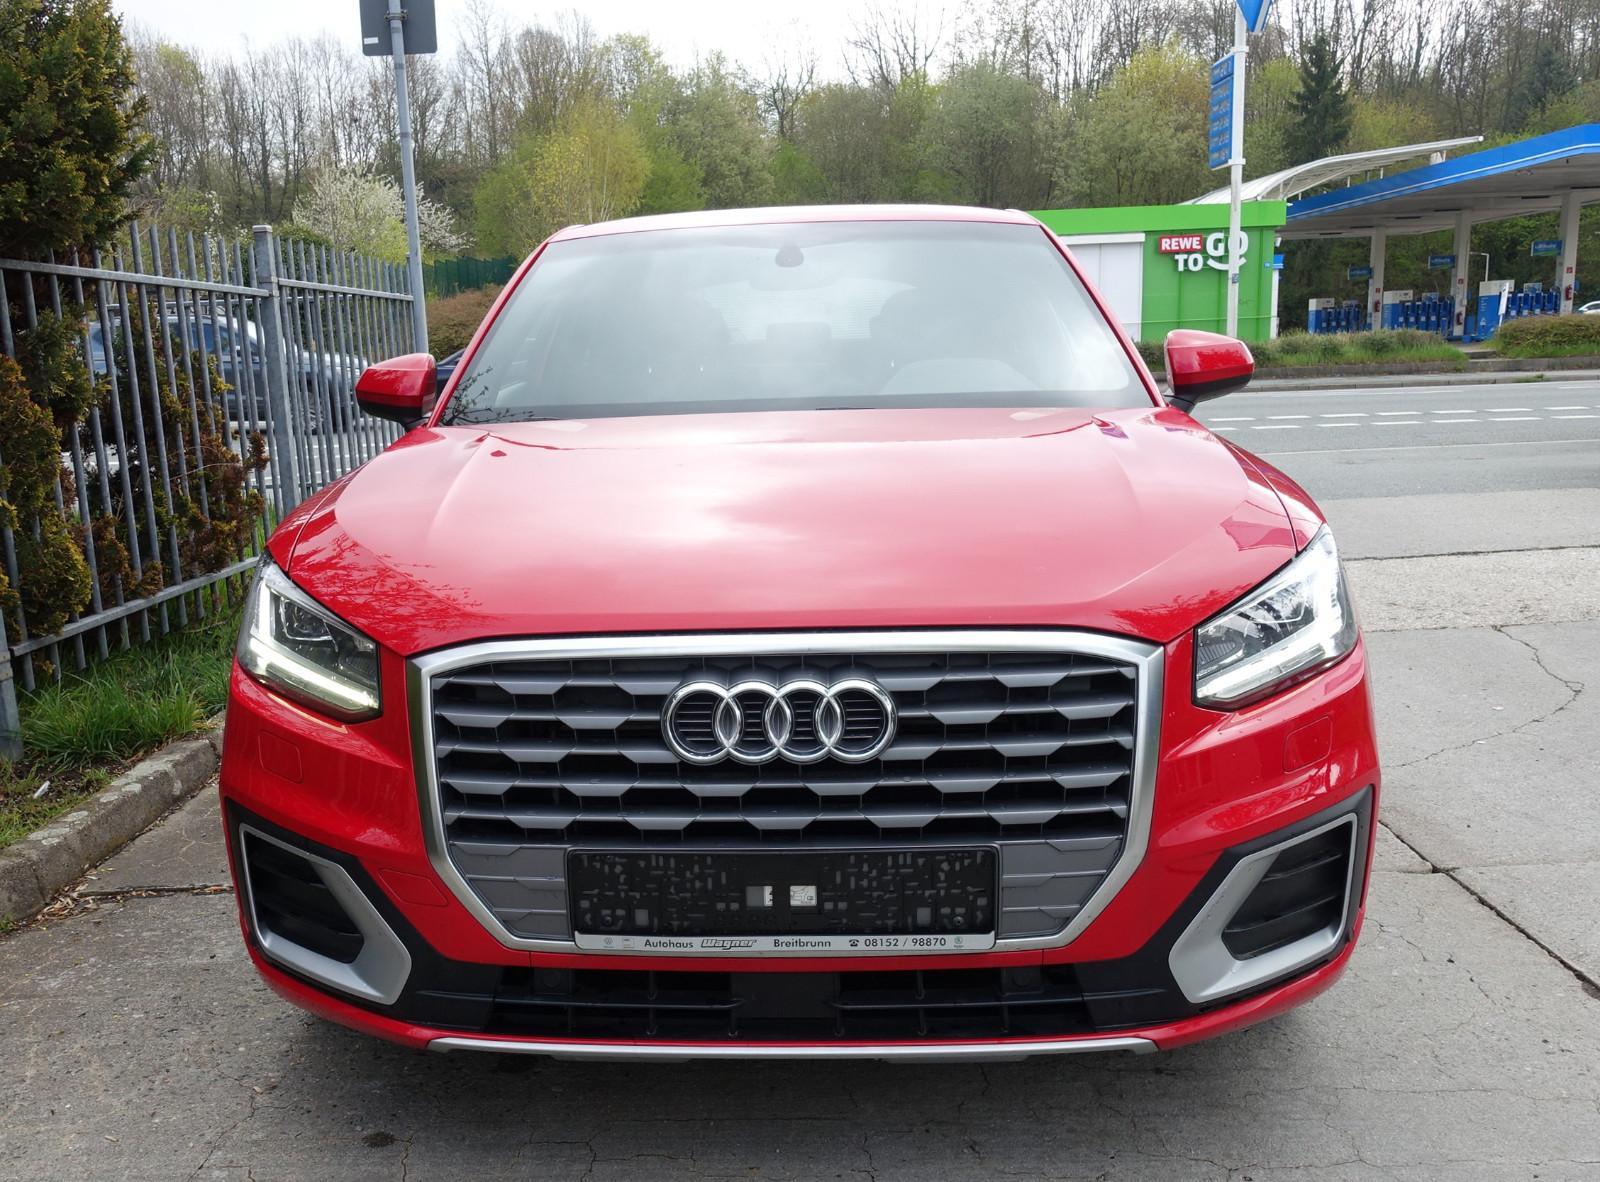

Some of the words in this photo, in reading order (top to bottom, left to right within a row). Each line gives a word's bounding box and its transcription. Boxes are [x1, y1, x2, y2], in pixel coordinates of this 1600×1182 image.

[1161, 237, 1202, 250] REWE
[1174, 253, 1204, 272] TO
[644, 939, 693, 948] Autohaus
[701, 938, 757, 950] Wagner
[774, 939, 831, 948] Breitbrunn
[864, 938, 899, 947] 08152
[911, 937, 947, 947] 98870
